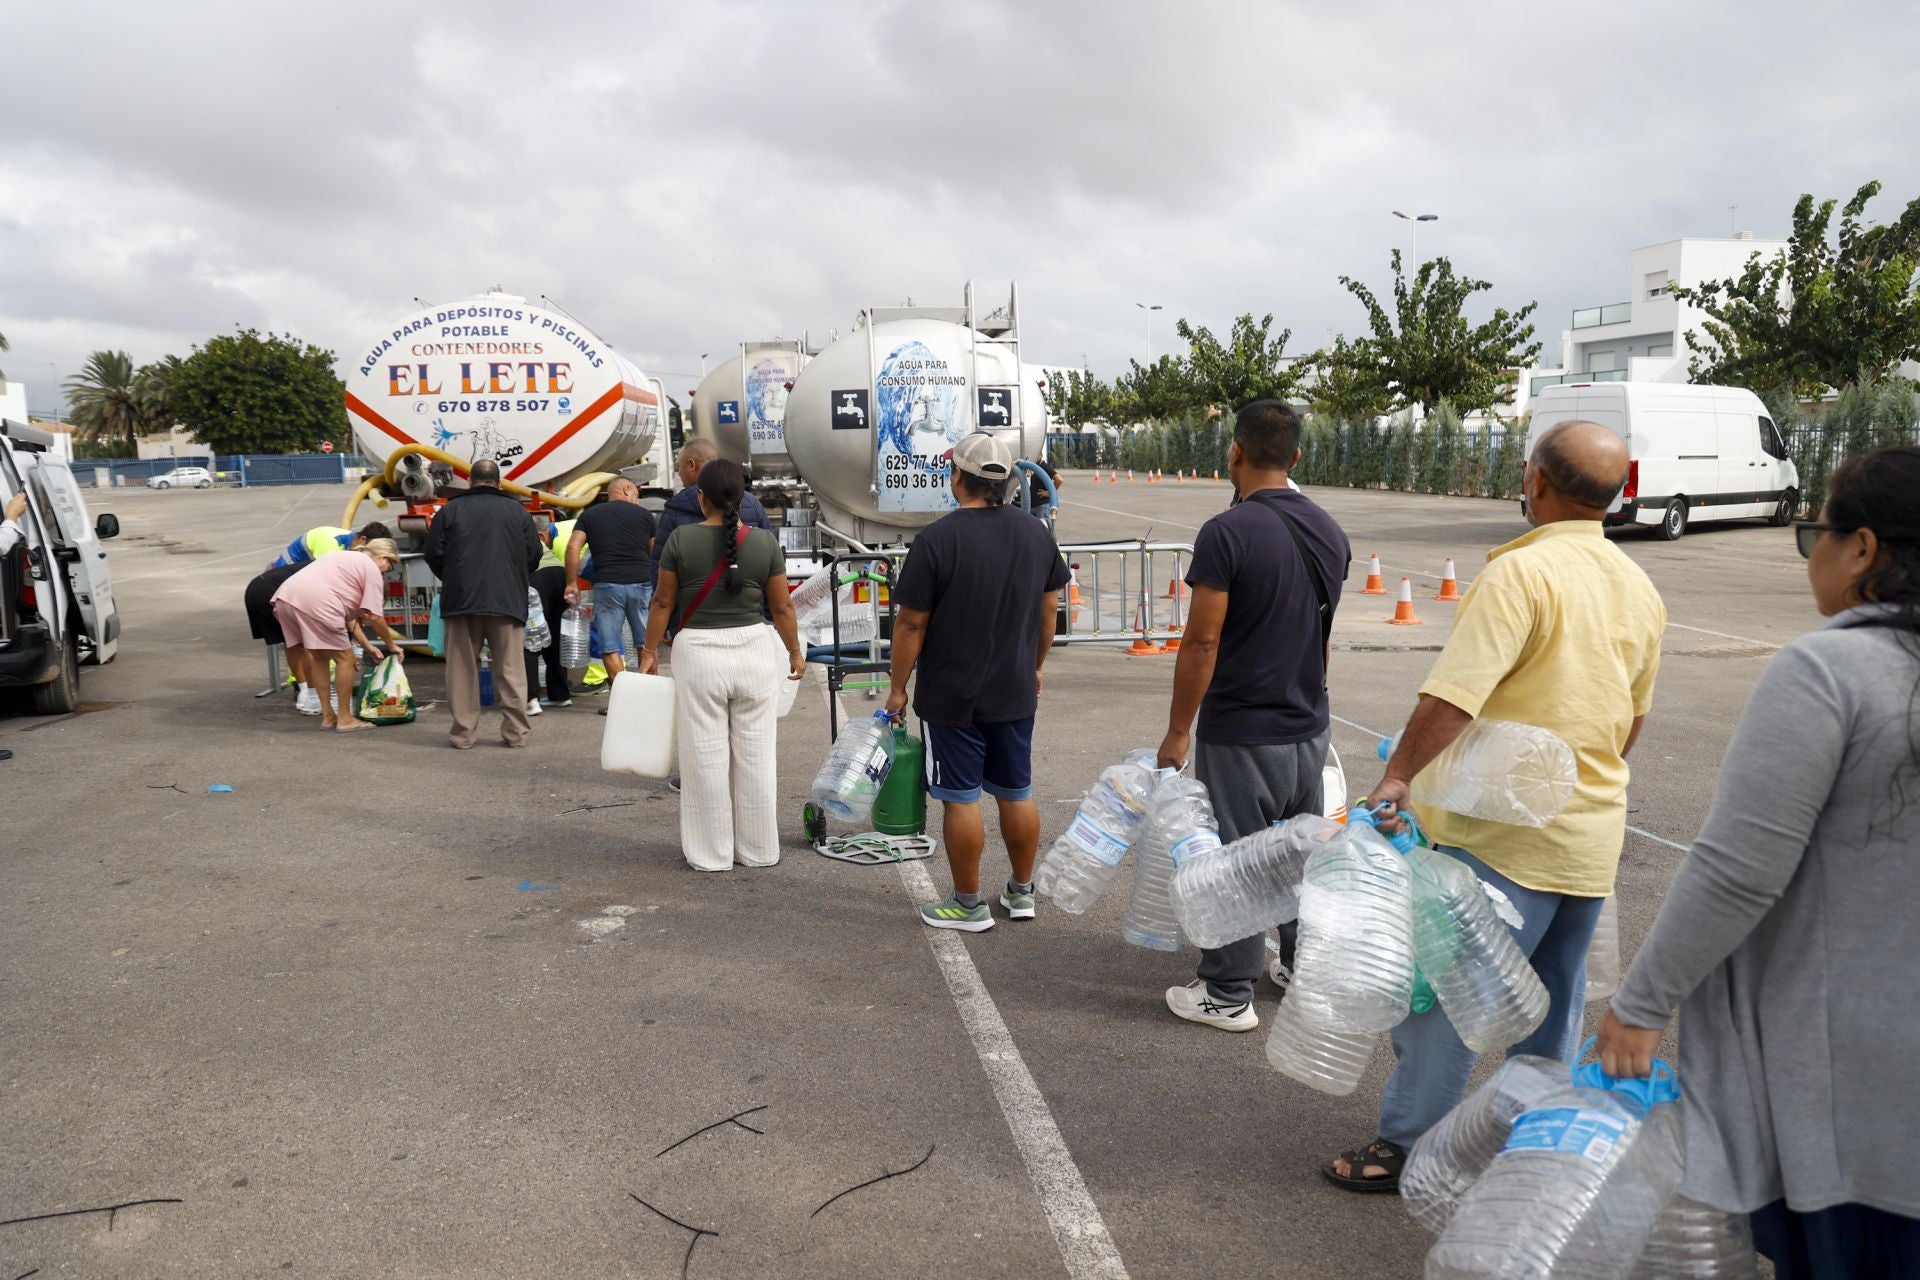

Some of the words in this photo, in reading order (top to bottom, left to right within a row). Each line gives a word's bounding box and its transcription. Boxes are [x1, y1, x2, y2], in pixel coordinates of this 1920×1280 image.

[441, 325, 509, 338] POTABLE
[360, 339, 393, 377] AGUA
[393, 316, 433, 342] PARA
[436, 304, 523, 323] DEPÓSITOS
[529, 313, 539, 325] Y
[541, 318, 604, 370] PISCINAS
[411, 341, 544, 357] CONTENEDORES
[899, 360, 922, 370] AGUA
[925, 360, 948, 370] PARA
[387, 363, 443, 396] EL
[460, 362, 575, 394] LETE
[881, 376, 926, 387] CONSUMO
[928, 376, 966, 386] HUMANO
[438, 401, 471, 413] 670
[476, 401, 511, 413] 878
[516, 400, 550, 412] 507
[751, 420, 765, 430] 629
[752, 431, 766, 440] 690
[767, 431, 776, 440] 36
[886, 455, 908, 470] 629
[912, 454, 927, 469] 77
[931, 454, 945, 469] 49
[886, 473, 908, 488] 690
[912, 473, 927, 488] 36
[931, 473, 944, 488] 81
